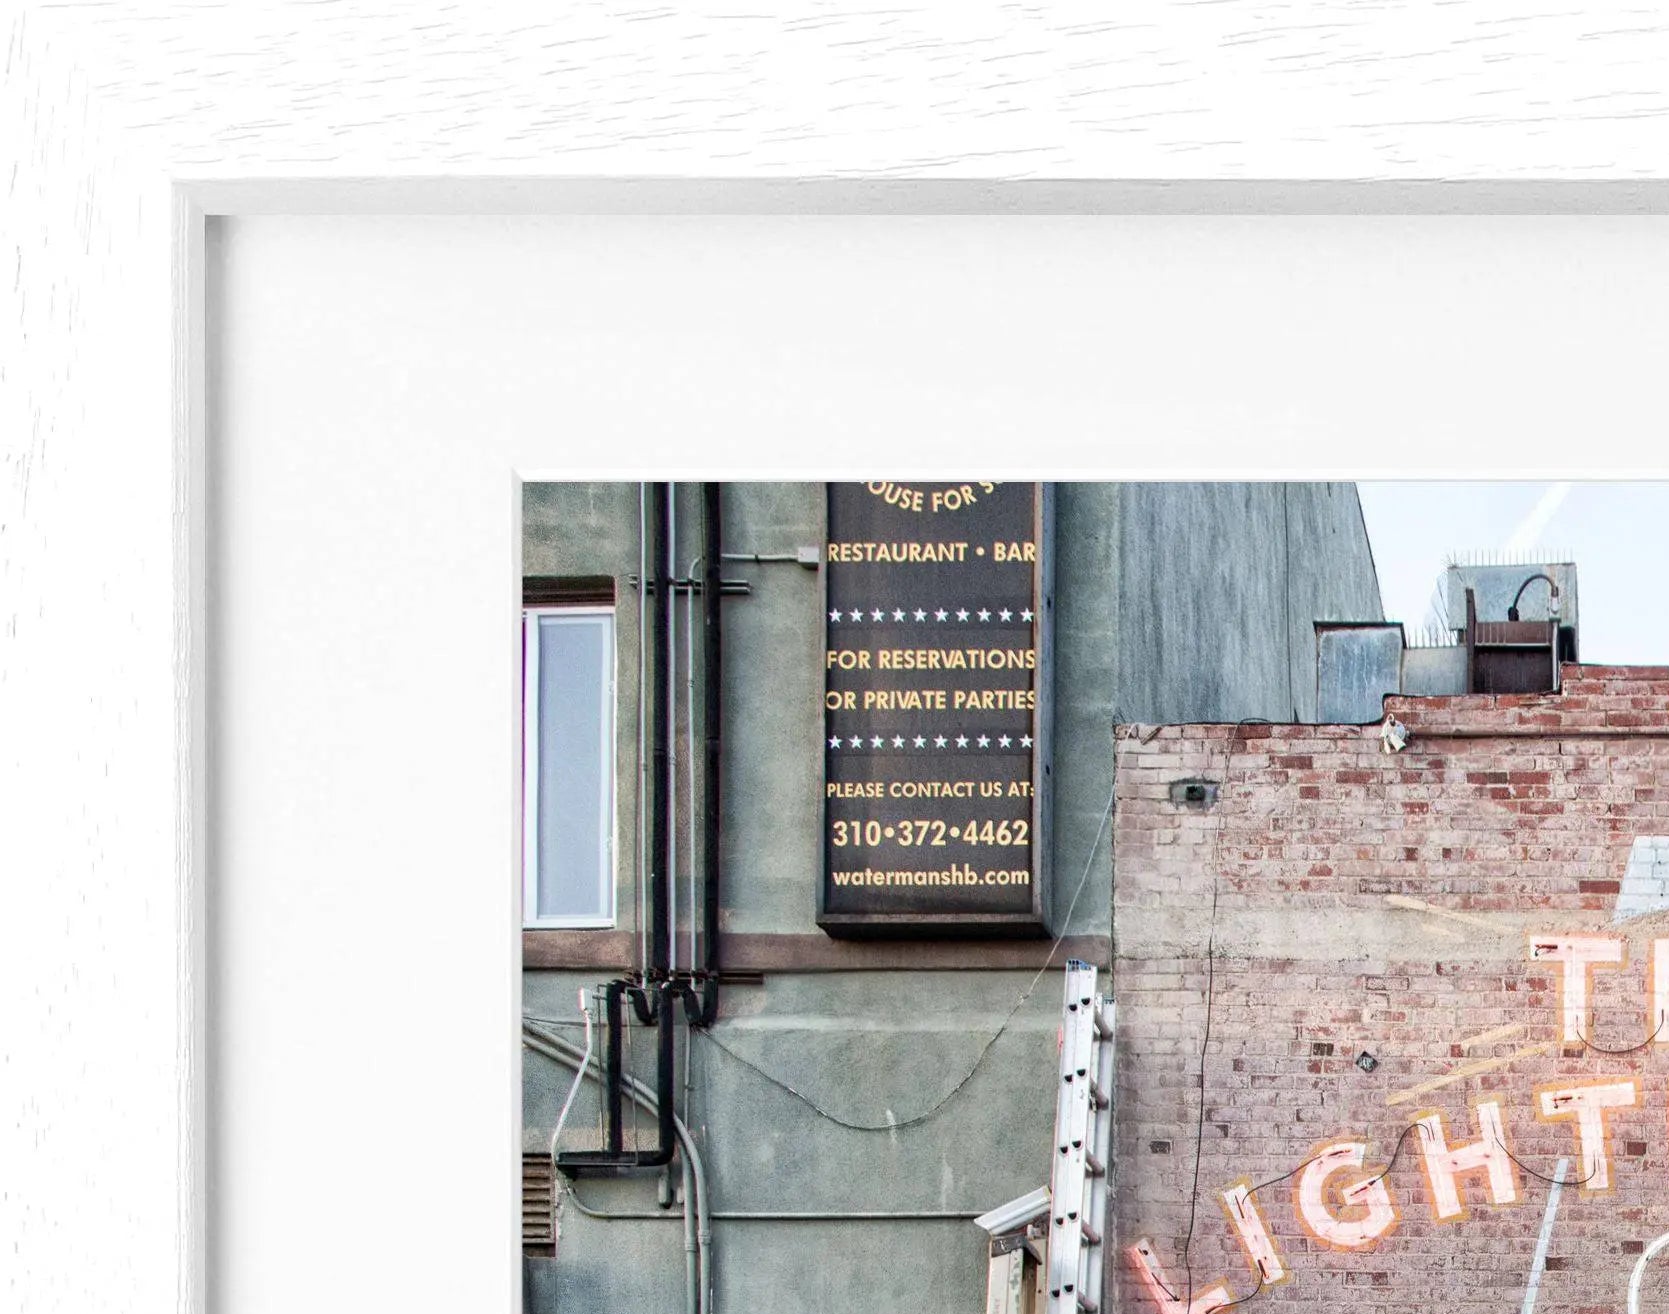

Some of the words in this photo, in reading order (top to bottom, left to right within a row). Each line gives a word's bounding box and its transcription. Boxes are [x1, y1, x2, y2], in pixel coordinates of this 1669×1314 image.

[860, 481, 924, 512] OUSE
[932, 484, 977, 513] FOR
[828, 542, 968, 562] RESTAURANT
[994, 541, 1035, 562] BAR
[827, 650, 871, 669] FOR
[879, 649, 1035, 669] RESERVATIONS
[826, 691, 857, 710] OR
[864, 690, 946, 710] PRIVATE
[954, 690, 1035, 710] PARTIES
[827, 783, 884, 798] PLEASE
[890, 782, 975, 798] CONTACT
[980, 781, 1003, 797] US
[832, 863, 1030, 886] watermanshb.com
